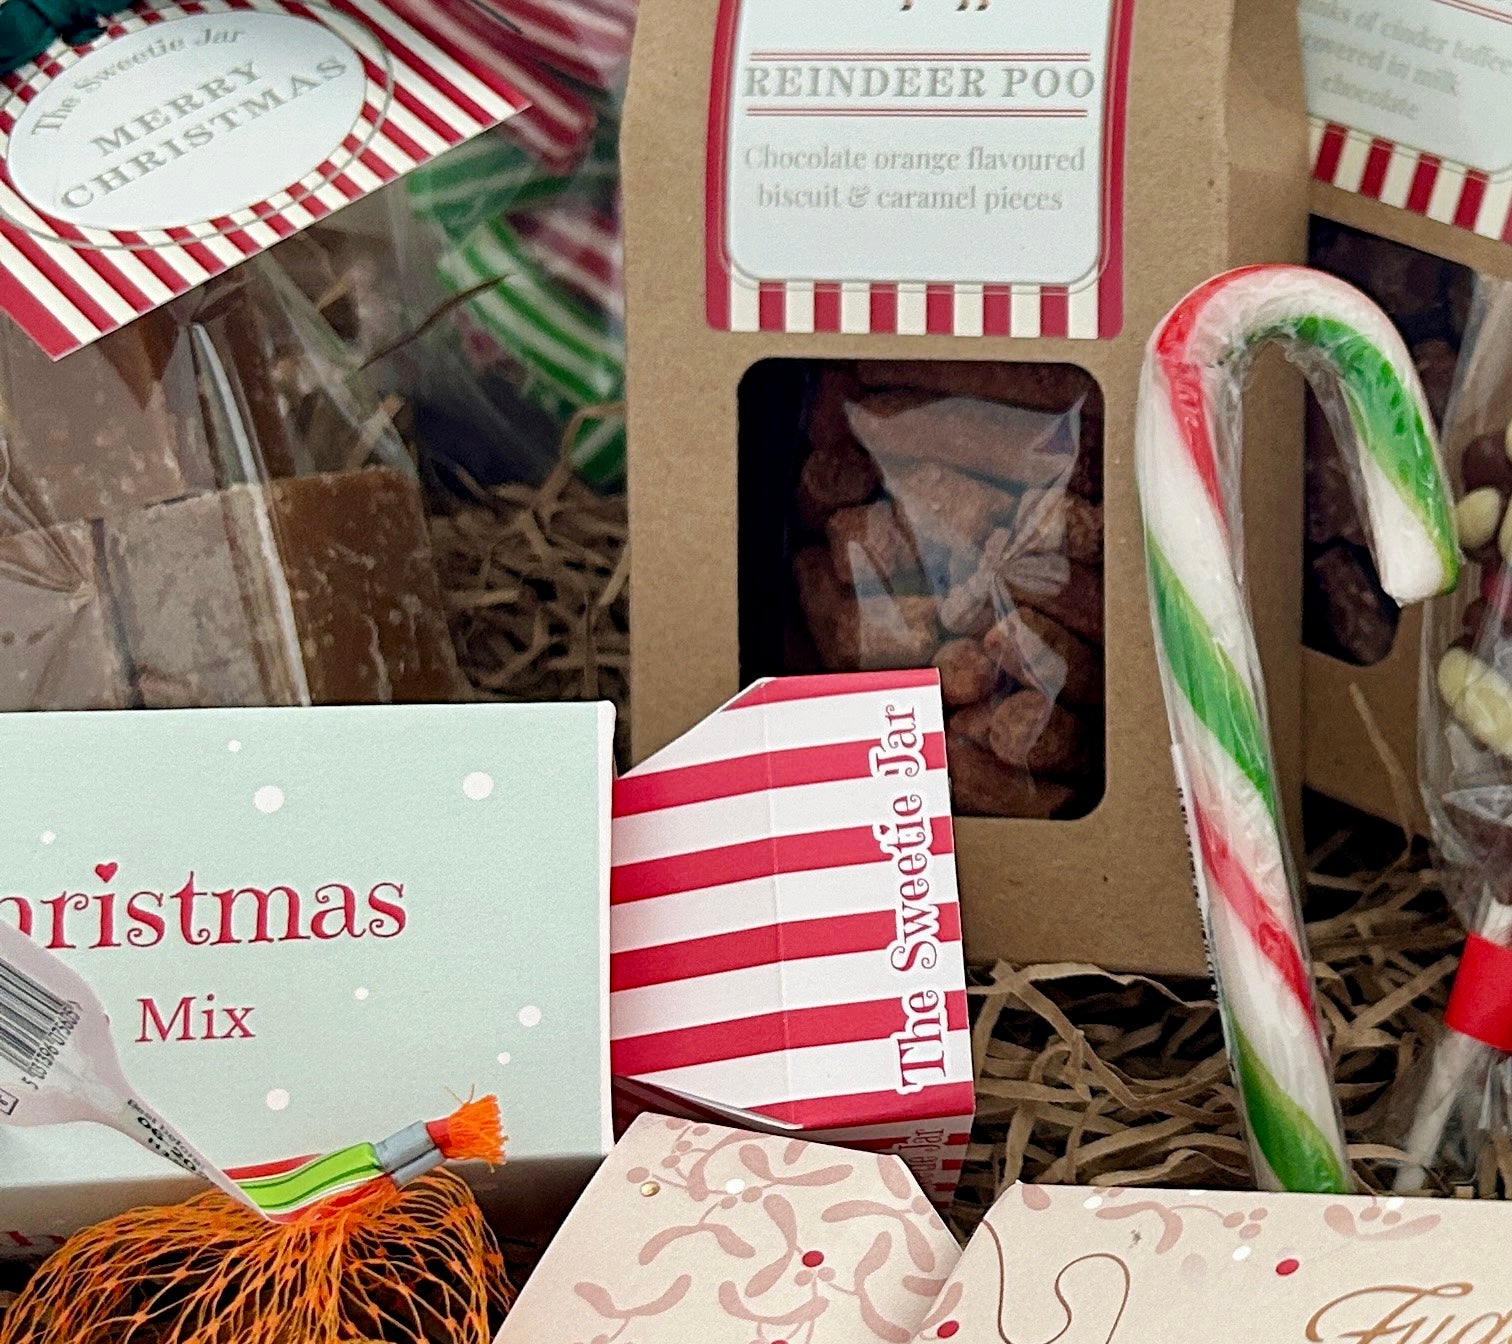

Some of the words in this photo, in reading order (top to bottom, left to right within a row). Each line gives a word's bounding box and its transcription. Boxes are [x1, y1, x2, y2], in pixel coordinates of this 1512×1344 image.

[30, 93, 80, 137] The
[73, 36, 186, 94] Sweetie
[194, 26, 245, 49] Jar
[92, 58, 263, 158] MERRY
[743, 64, 987, 99] REINDEER
[1002, 66, 1096, 99] POO
[61, 60, 348, 209] CHRISTMAS
[743, 143, 867, 173] Chocolate
[874, 149, 961, 176] orange
[967, 146, 1086, 174] flavoured
[757, 183, 841, 210] biscuit
[847, 184, 869, 210] &
[877, 184, 978, 211] caramel
[983, 187, 1064, 215] pieces
[875, 704, 921, 778] Jar
[879, 793, 939, 973] Sweetie
[134, 993, 257, 1044] Mix
[902, 989, 946, 1088] The
[899, 1128, 945, 1152] Jar
